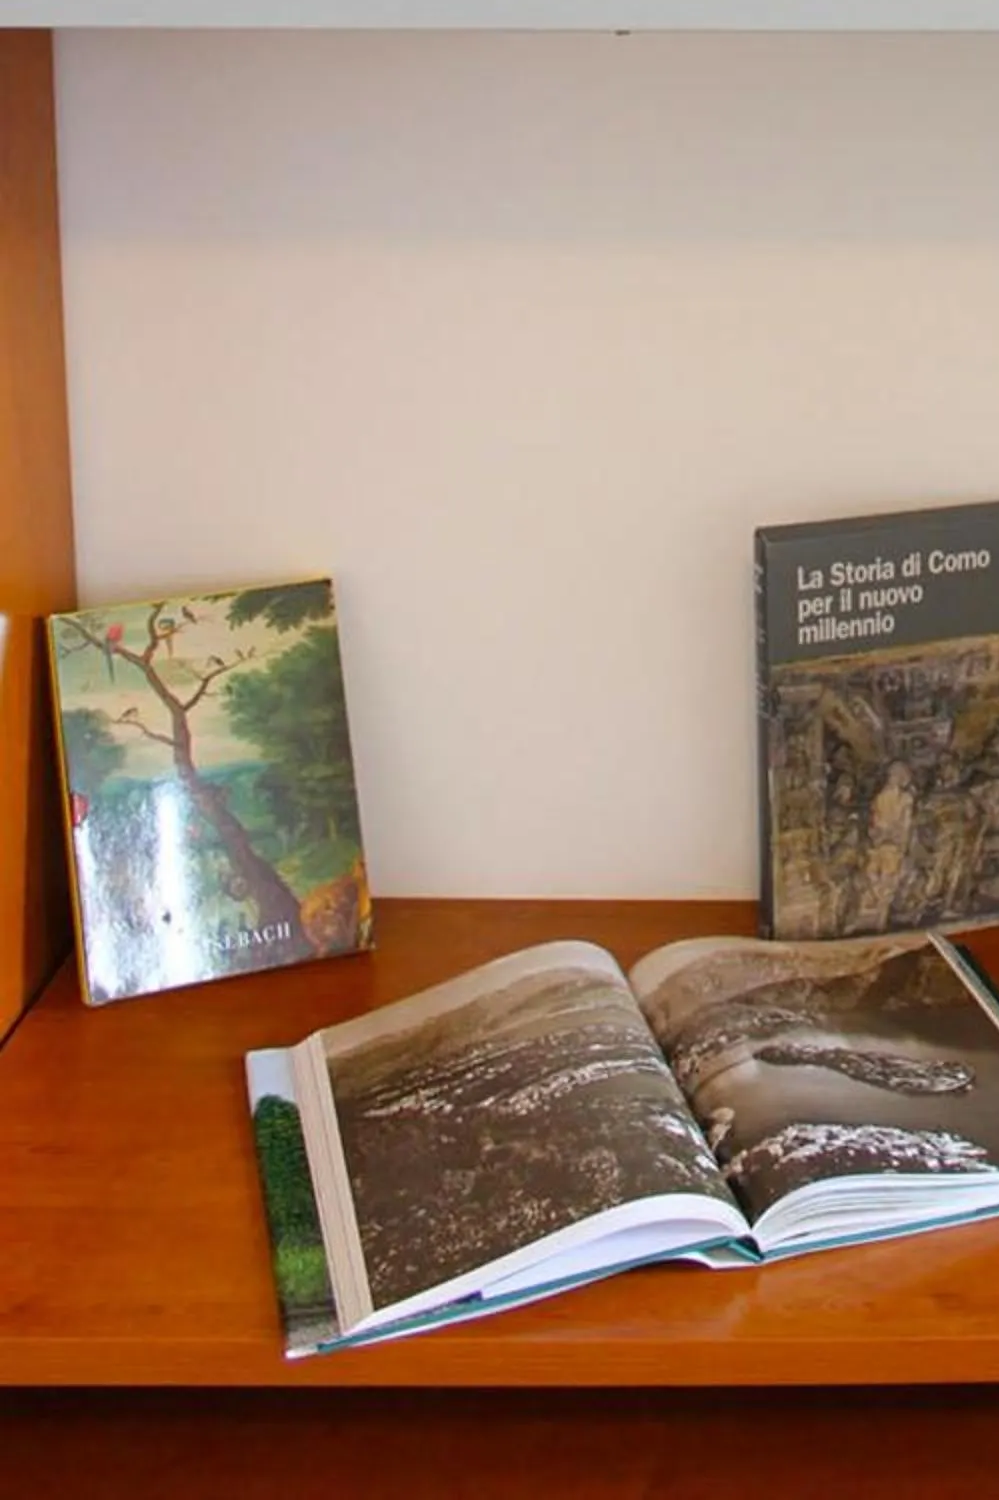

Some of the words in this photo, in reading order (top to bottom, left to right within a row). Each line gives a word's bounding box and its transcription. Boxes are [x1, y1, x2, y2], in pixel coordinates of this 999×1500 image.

[798, 566, 823, 590] La
[830, 557, 895, 586] Storia
[902, 552, 921, 577] di
[928, 550, 990, 574] Como
[798, 596, 834, 623] per
[839, 587, 852, 612] il
[859, 584, 923, 609] nuovo
[798, 611, 895, 645] millennio
